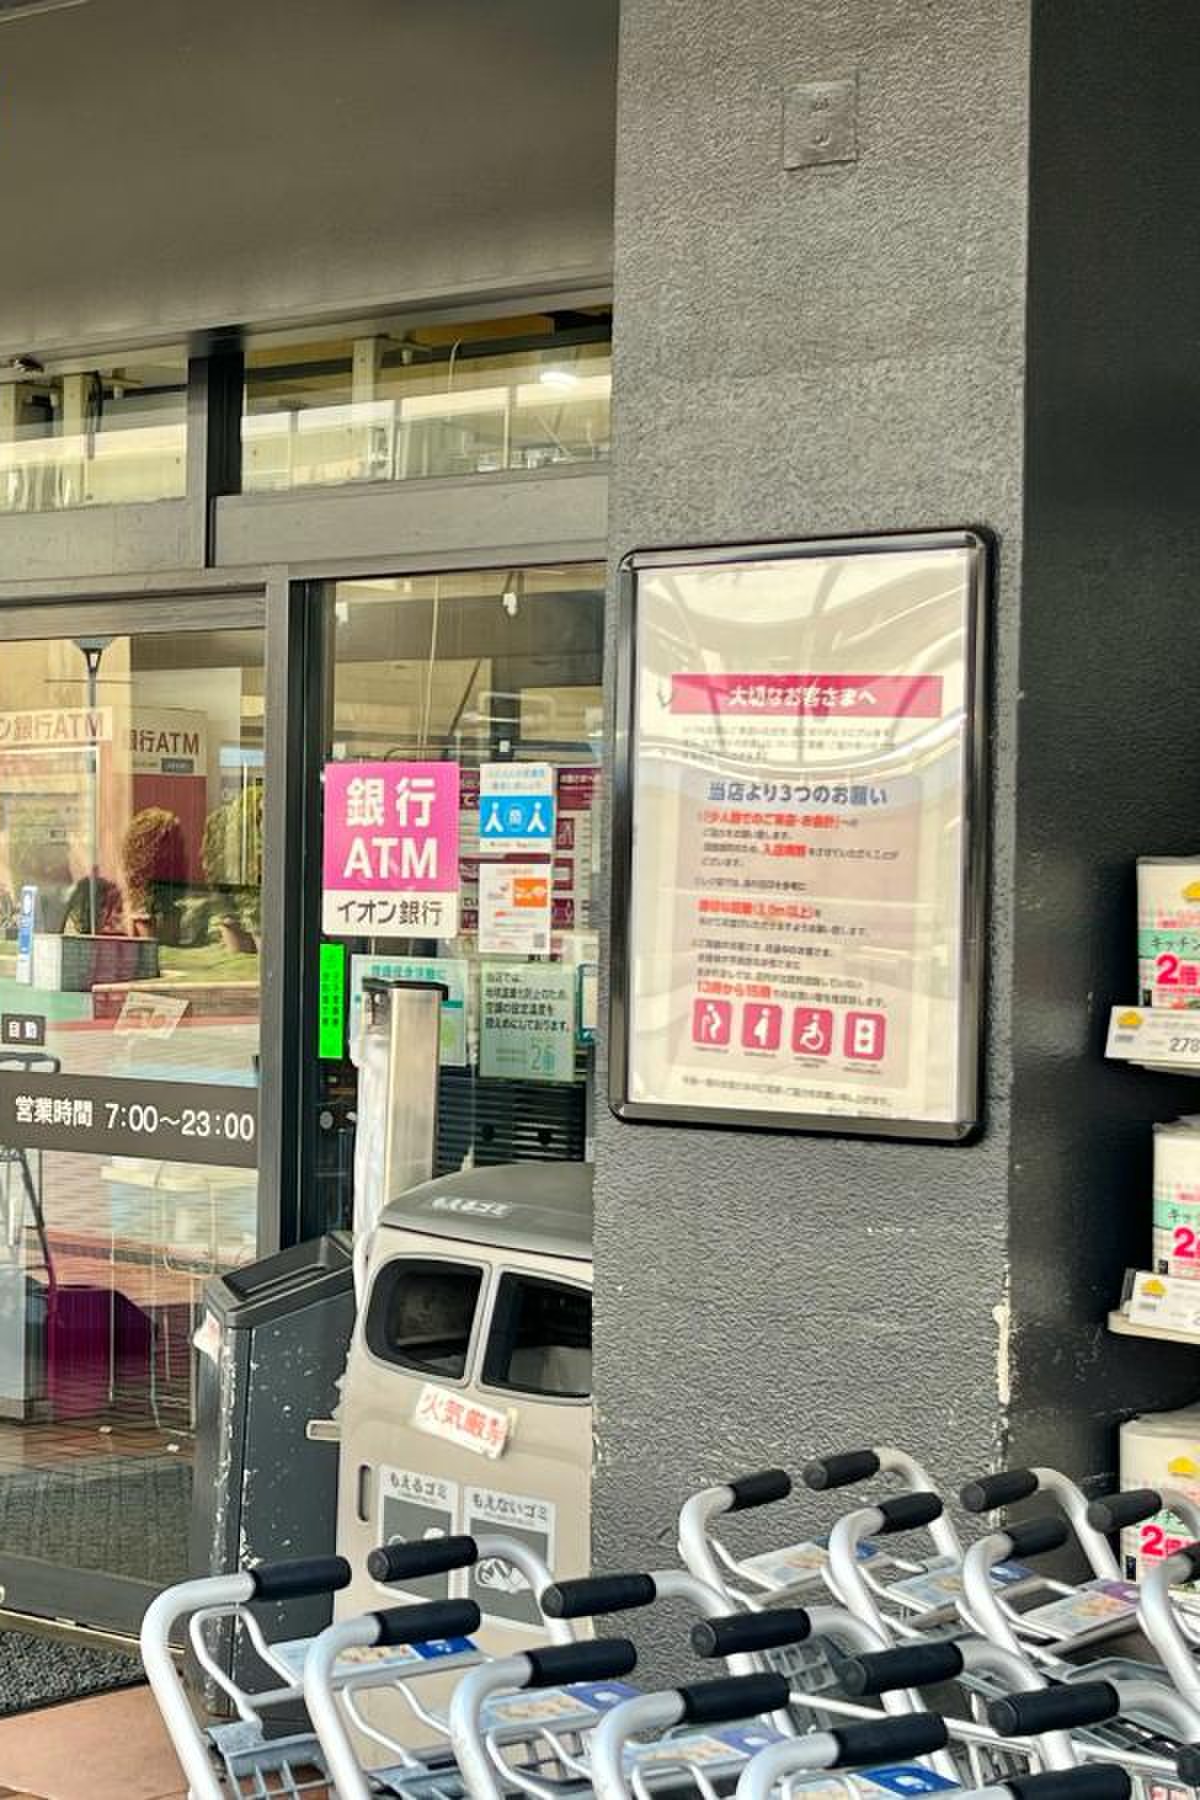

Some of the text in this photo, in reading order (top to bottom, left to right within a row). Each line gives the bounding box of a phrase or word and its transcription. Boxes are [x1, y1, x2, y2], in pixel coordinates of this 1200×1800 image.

[727, 684, 877, 707] 大切なお客さまへ
[345, 777, 437, 828] 銀行
[709, 781, 888, 806] 当店より3つのお願い
[342, 836, 438, 880] ATM
[336, 898, 443, 927] イオン銀行
[8, 1020, 38, 1039] 自動
[15, 1095, 93, 1129] 営業時間
[390, 1471, 448, 1500] もえるゴミ
[473, 1493, 548, 1521] もえないゴミ
